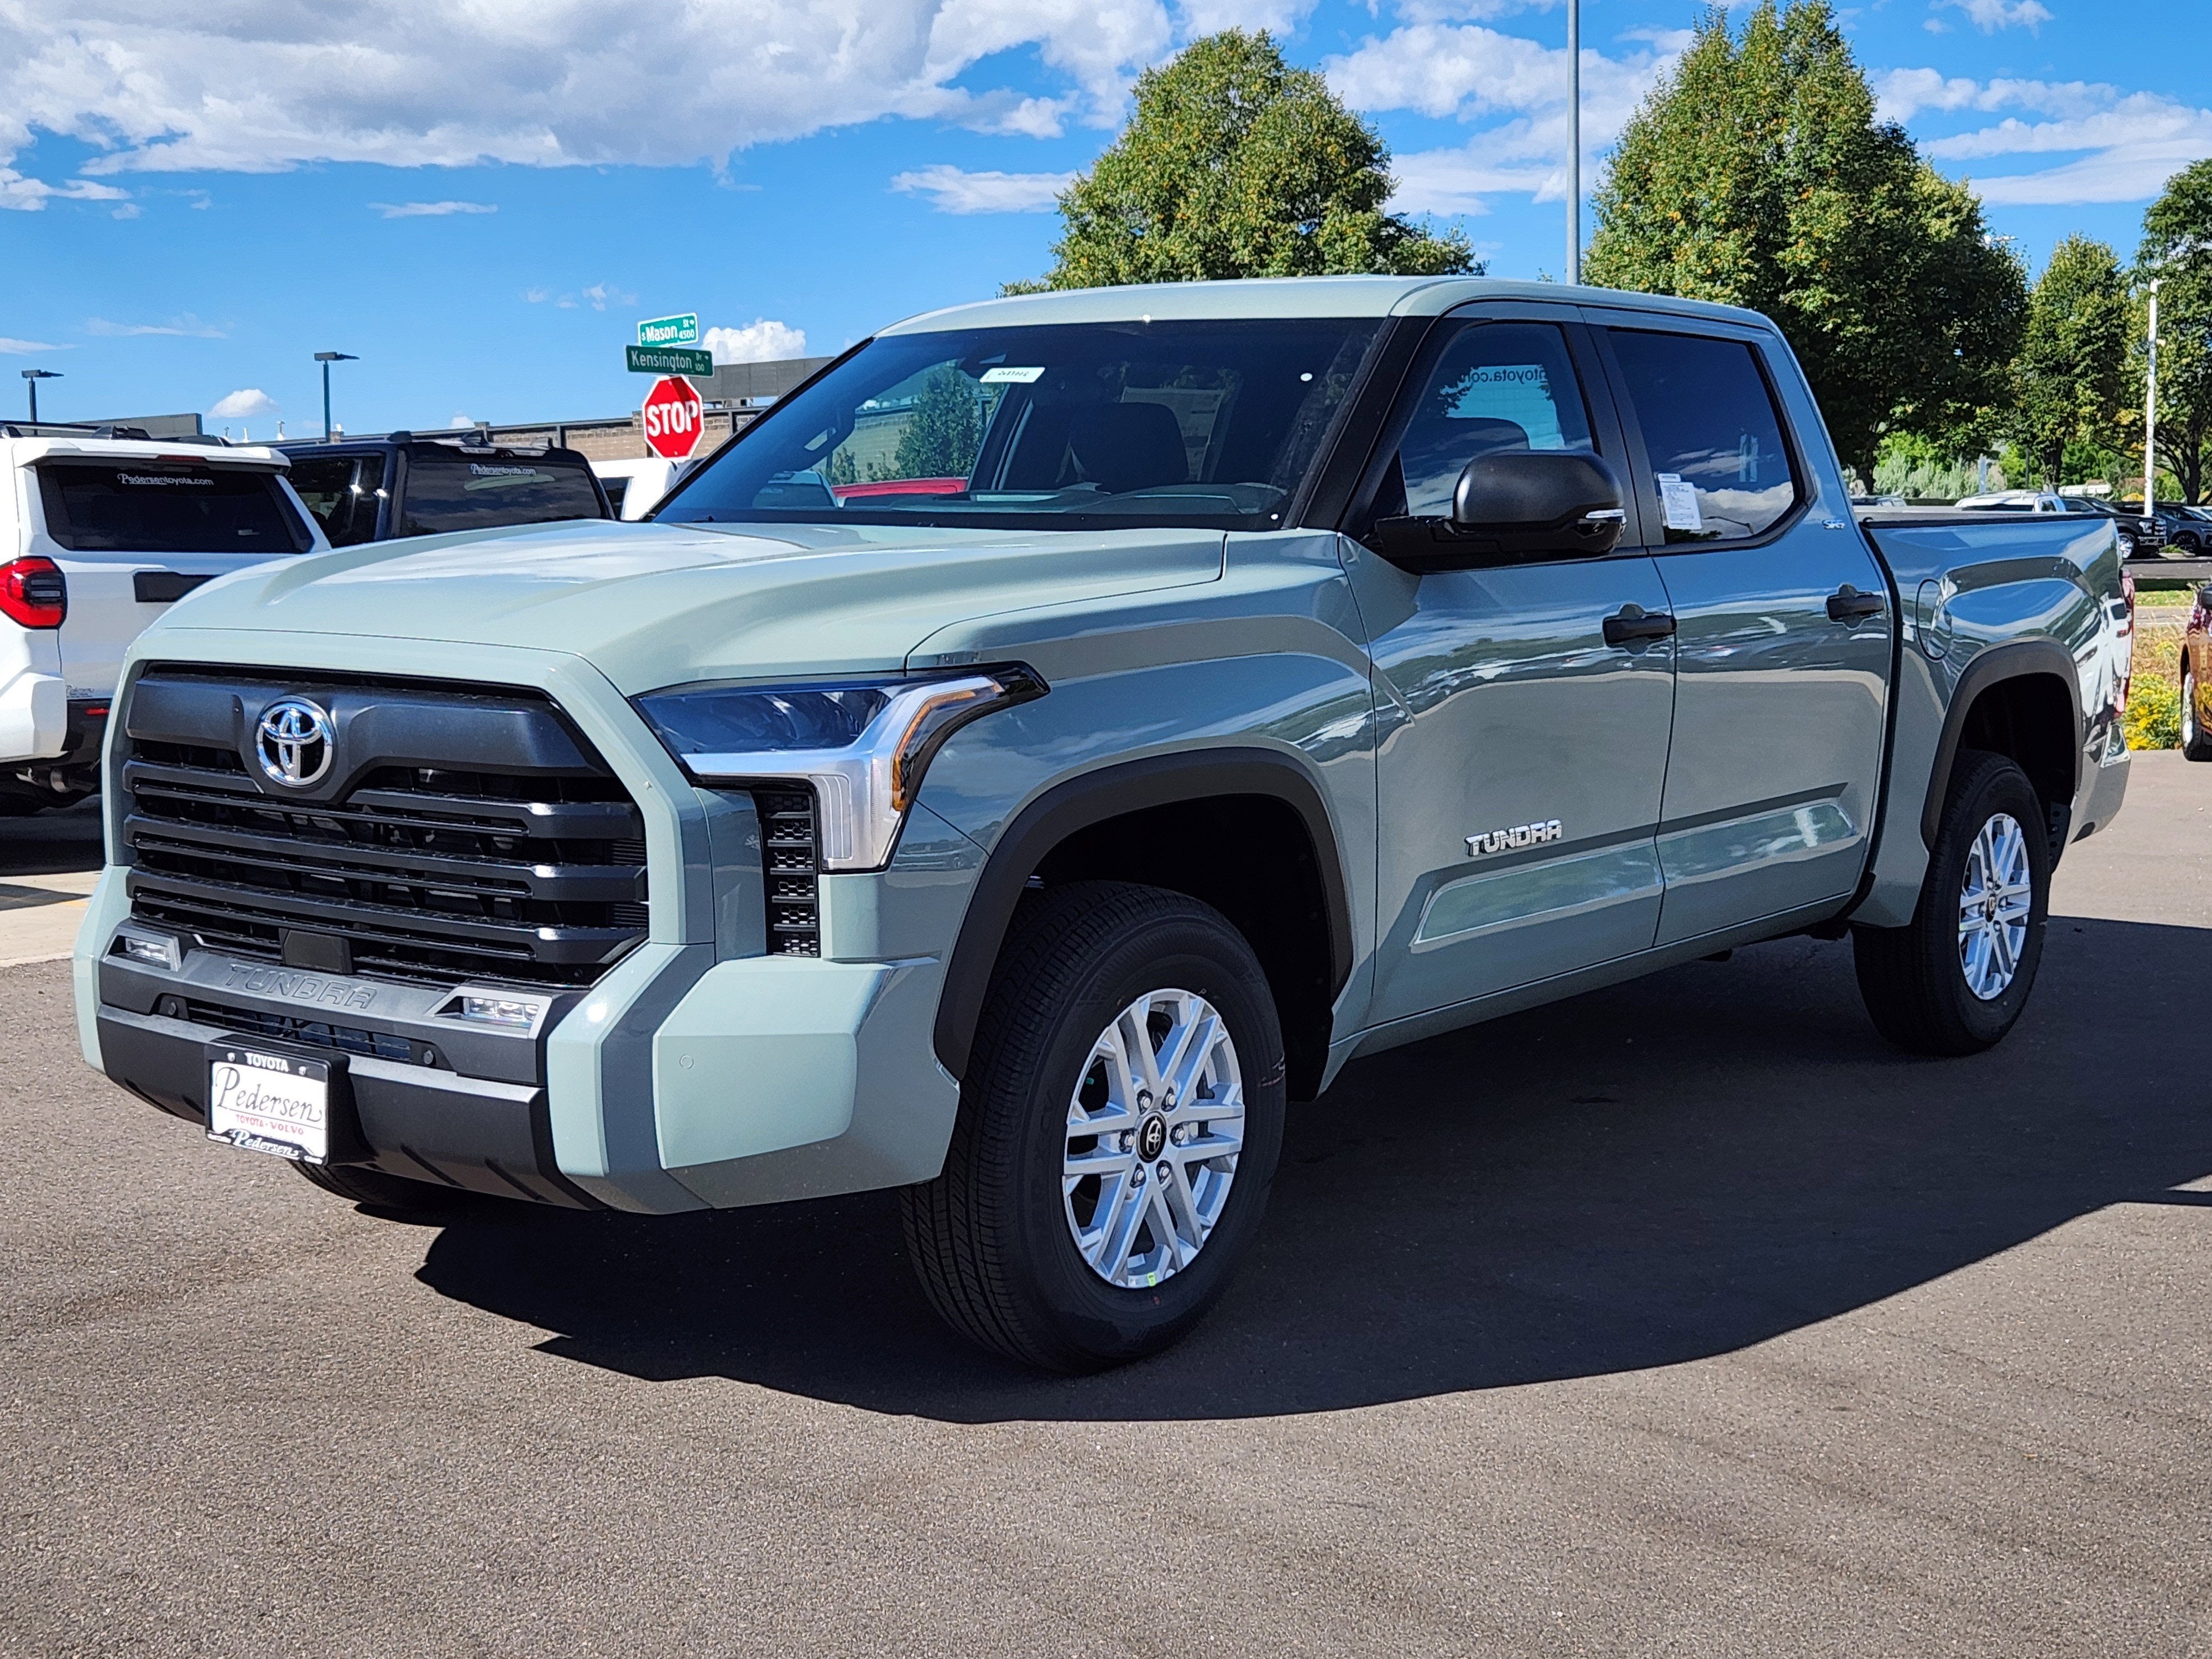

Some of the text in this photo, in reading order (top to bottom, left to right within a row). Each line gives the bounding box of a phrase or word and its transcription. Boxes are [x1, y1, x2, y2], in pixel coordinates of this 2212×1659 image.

[645, 325, 678, 343] Mason
[682, 319, 690, 328] St
[631, 350, 702, 372] Kensington Dr
[695, 363, 705, 372] 100
[646, 399, 698, 437] STOP
[1464, 818, 1562, 857] TUNDRA
[225, 964, 378, 1010] TUNDRA
[244, 1052, 290, 1072] TOYOTA
[215, 1066, 323, 1123] Pedersen
[236, 1114, 304, 1135] TOYOTA VOLVO
[229, 1129, 300, 1157] Pedersen
